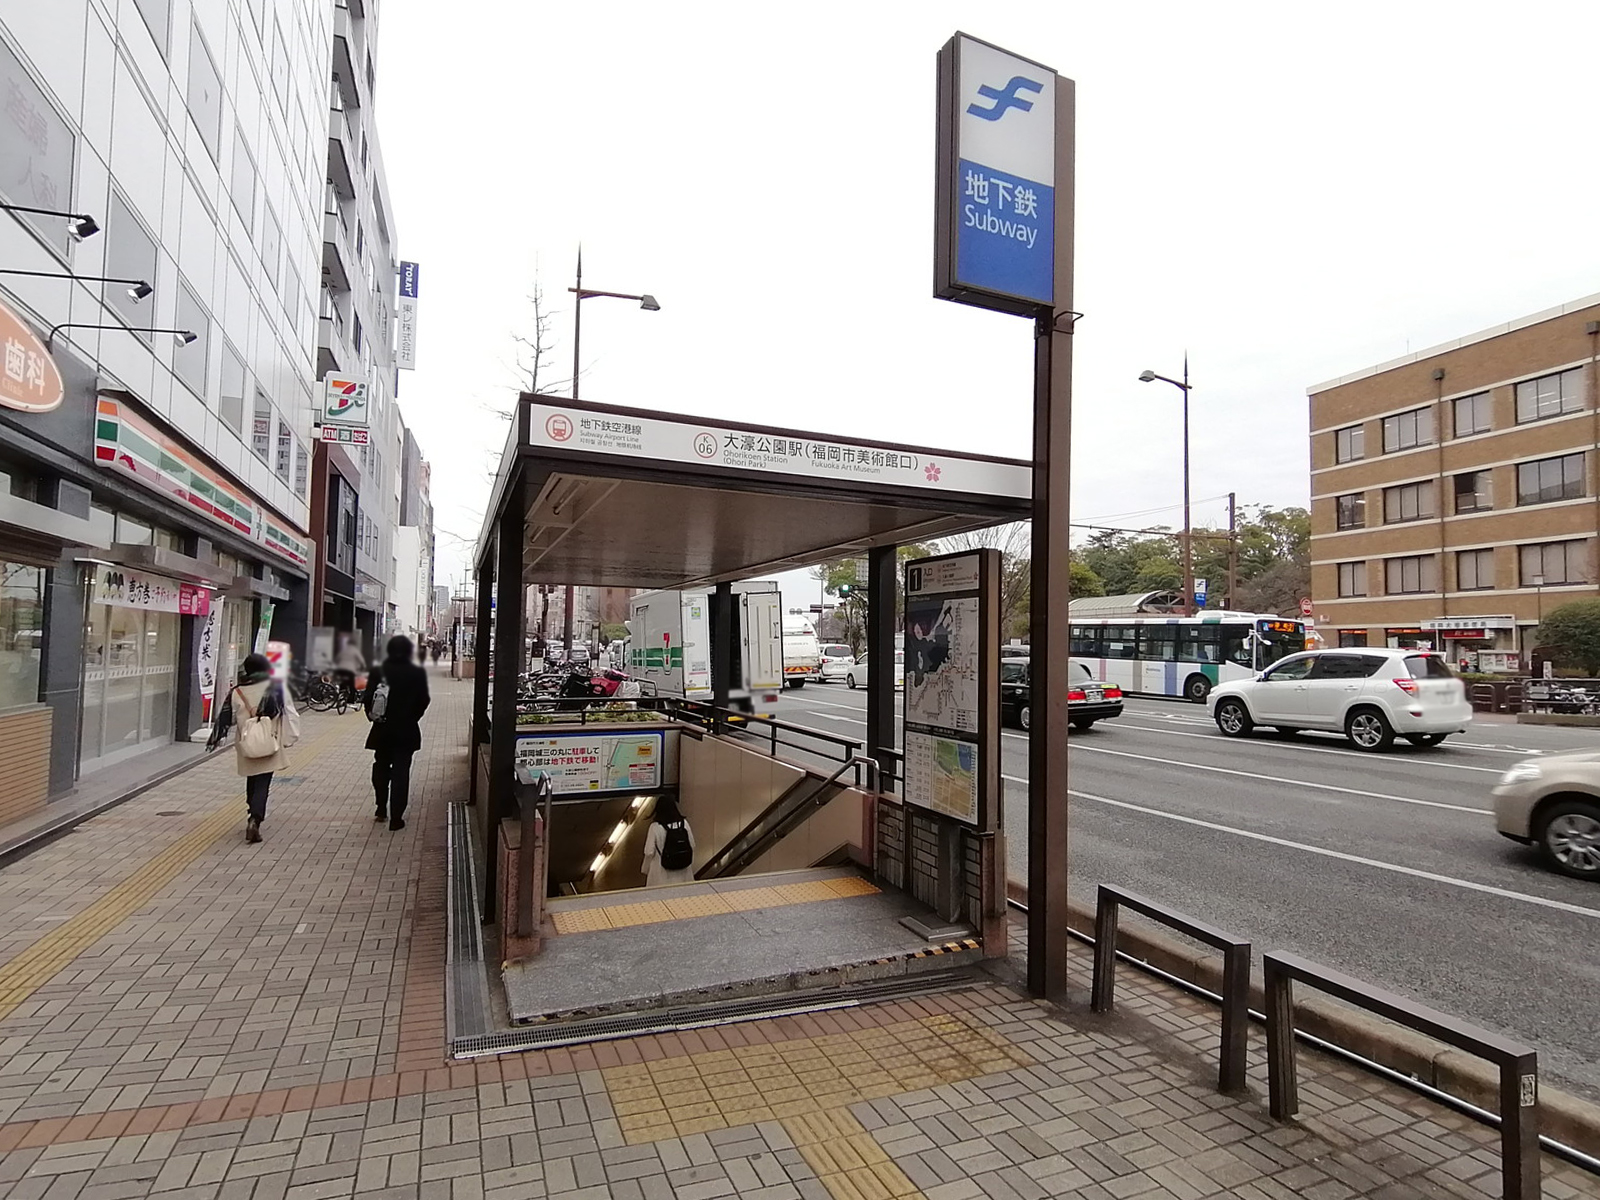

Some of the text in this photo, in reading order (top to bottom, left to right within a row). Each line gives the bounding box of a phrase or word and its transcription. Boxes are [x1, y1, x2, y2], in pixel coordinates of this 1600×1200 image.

[965, 169, 1038, 219] 地下鉄
[964, 204, 1038, 249] Subway
[401, 303, 413, 362] 東レ株式会社
[5, 336, 45, 396] 歯科
[323, 428, 337, 440] ATM
[580, 417, 642, 435] 地下鉄空港線
[580, 430, 639, 443] Subway Airport Line
[699, 443, 713, 454] 06
[723, 433, 919, 471] 大濠公園駅(福岡市美術館口)
[723, 449, 789, 464] Ohorikoen Station
[723, 457, 767, 469] (Ohori Park)
[811, 459, 881, 474] Fukuoka Art Museum
[912, 569, 918, 590] 1
[520, 747, 600, 758] 福岡城三の丸に駐車して
